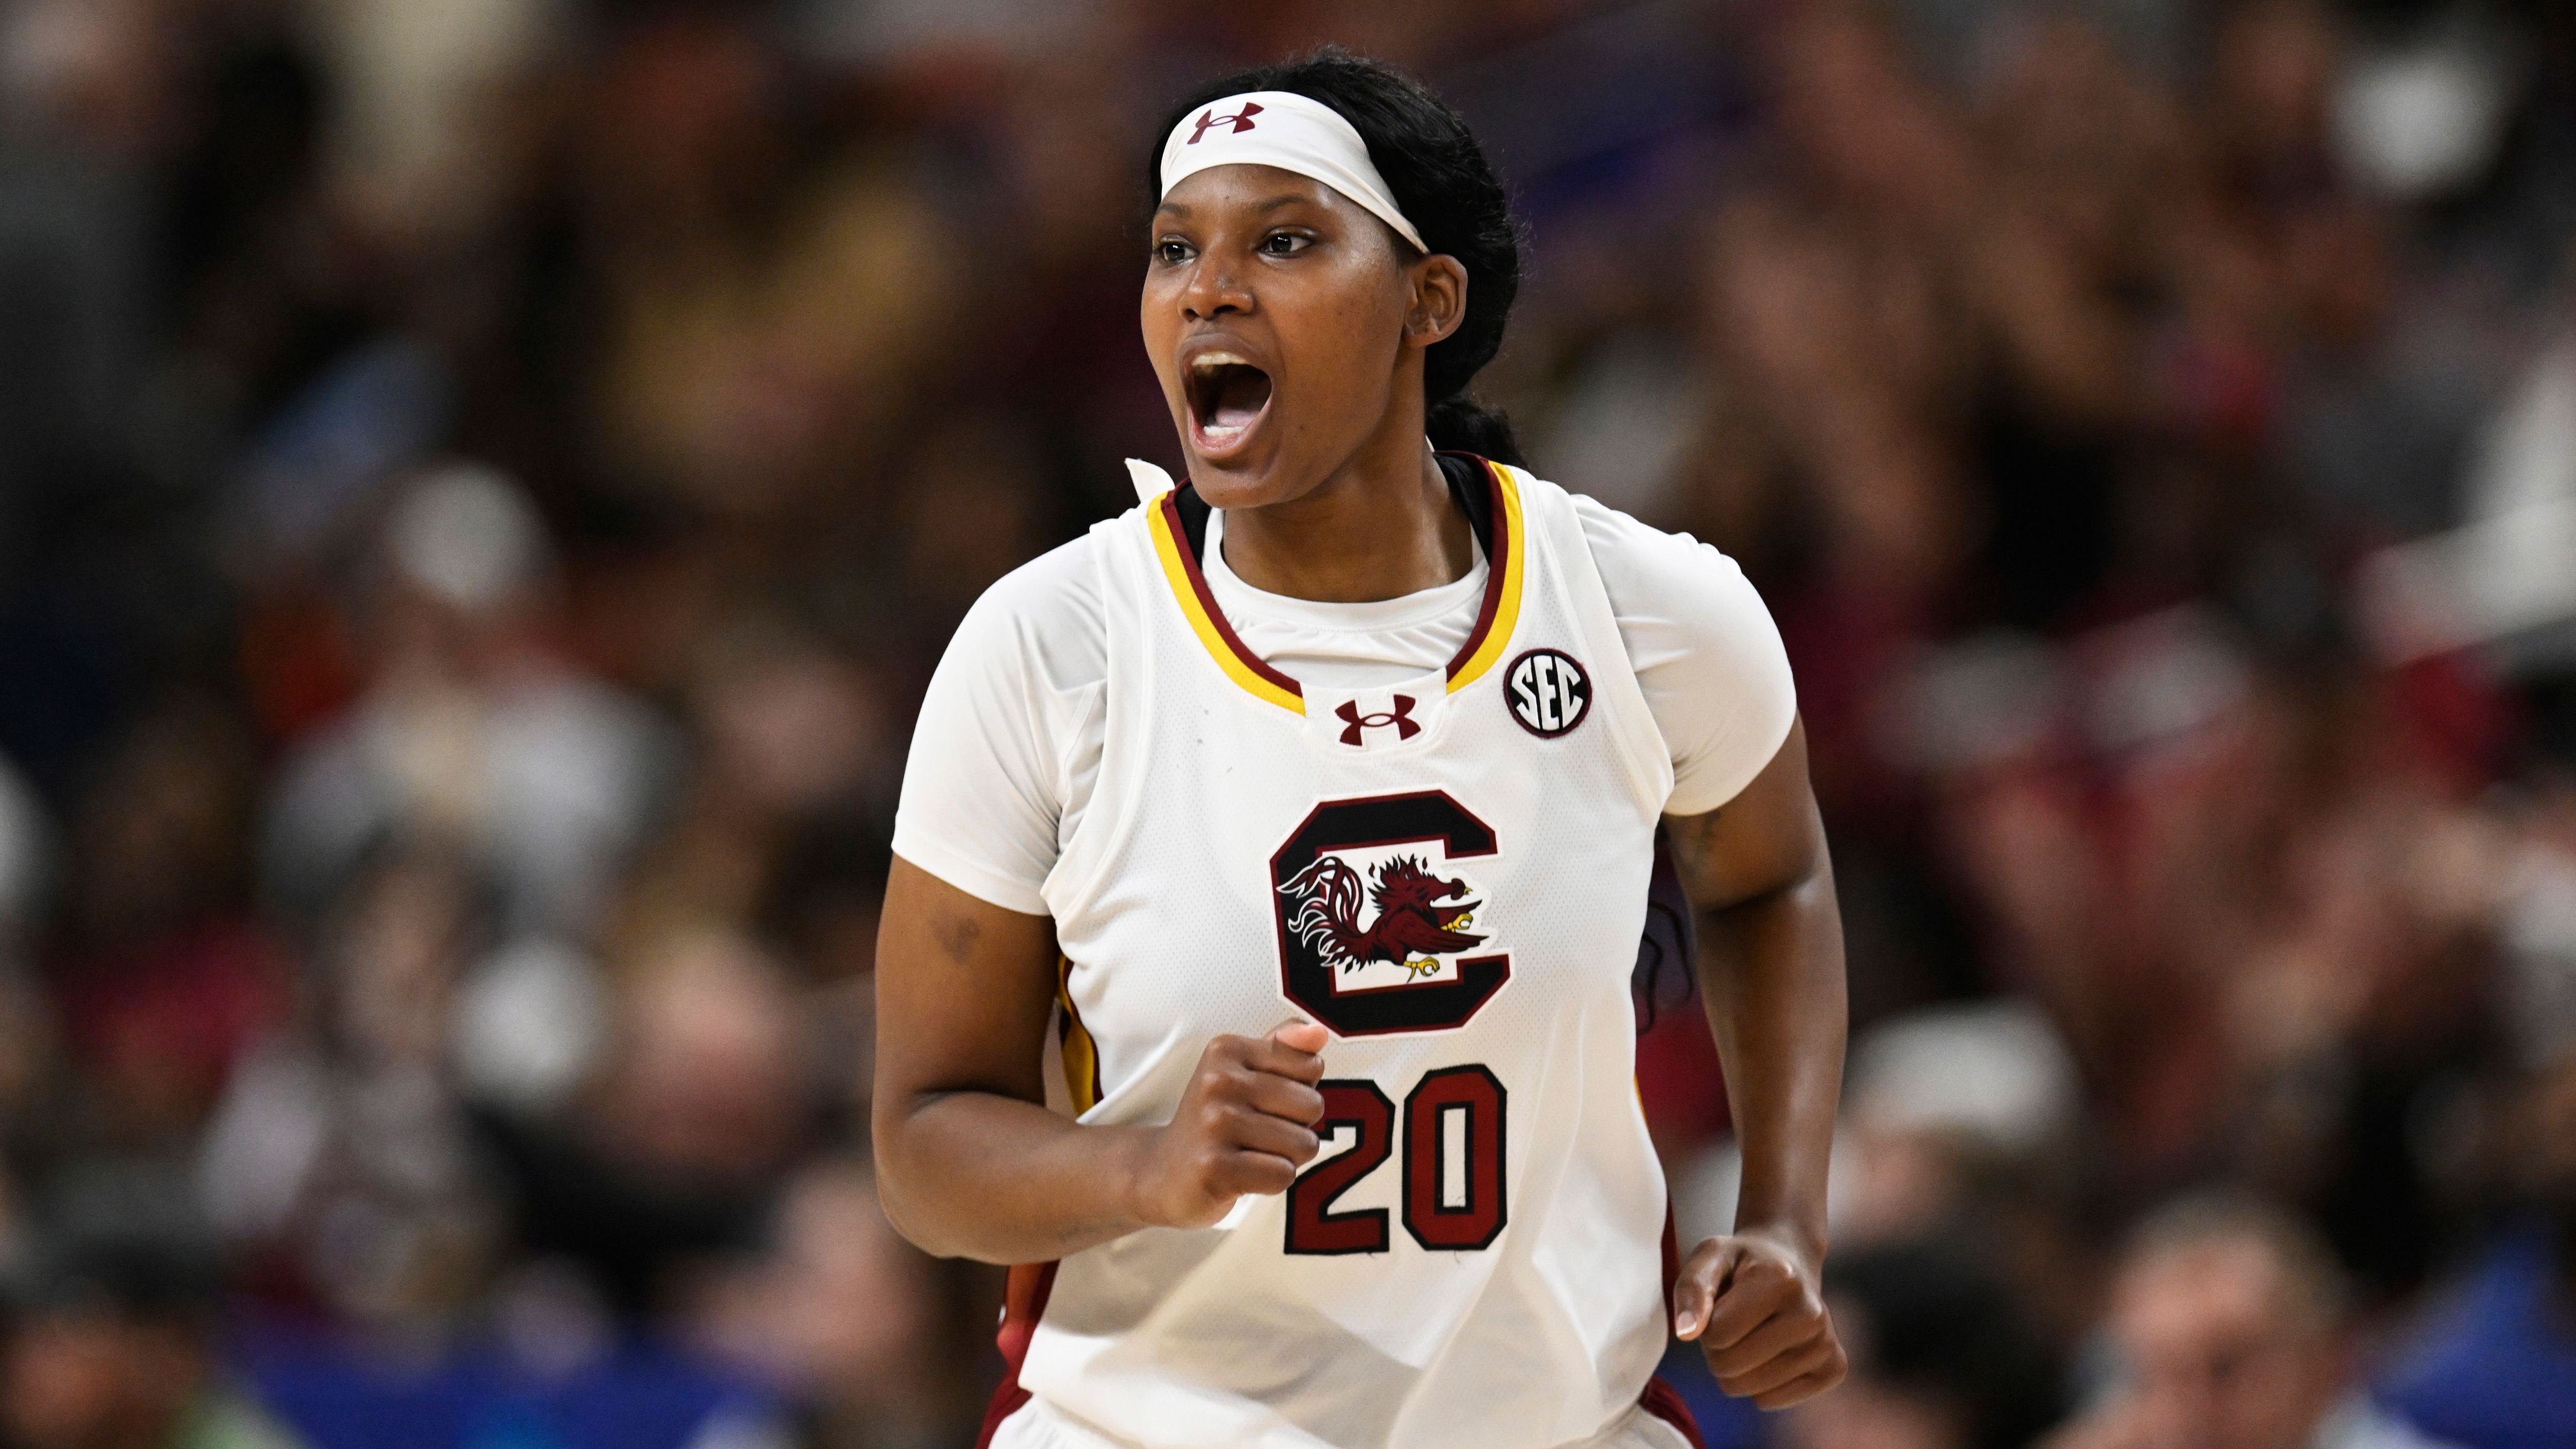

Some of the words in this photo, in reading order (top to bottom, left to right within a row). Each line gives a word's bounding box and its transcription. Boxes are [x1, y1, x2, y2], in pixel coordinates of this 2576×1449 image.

[1512, 655, 1583, 730] SEC
[1269, 789, 1510, 1037] C
[1284, 1064, 1507, 1255] 20
